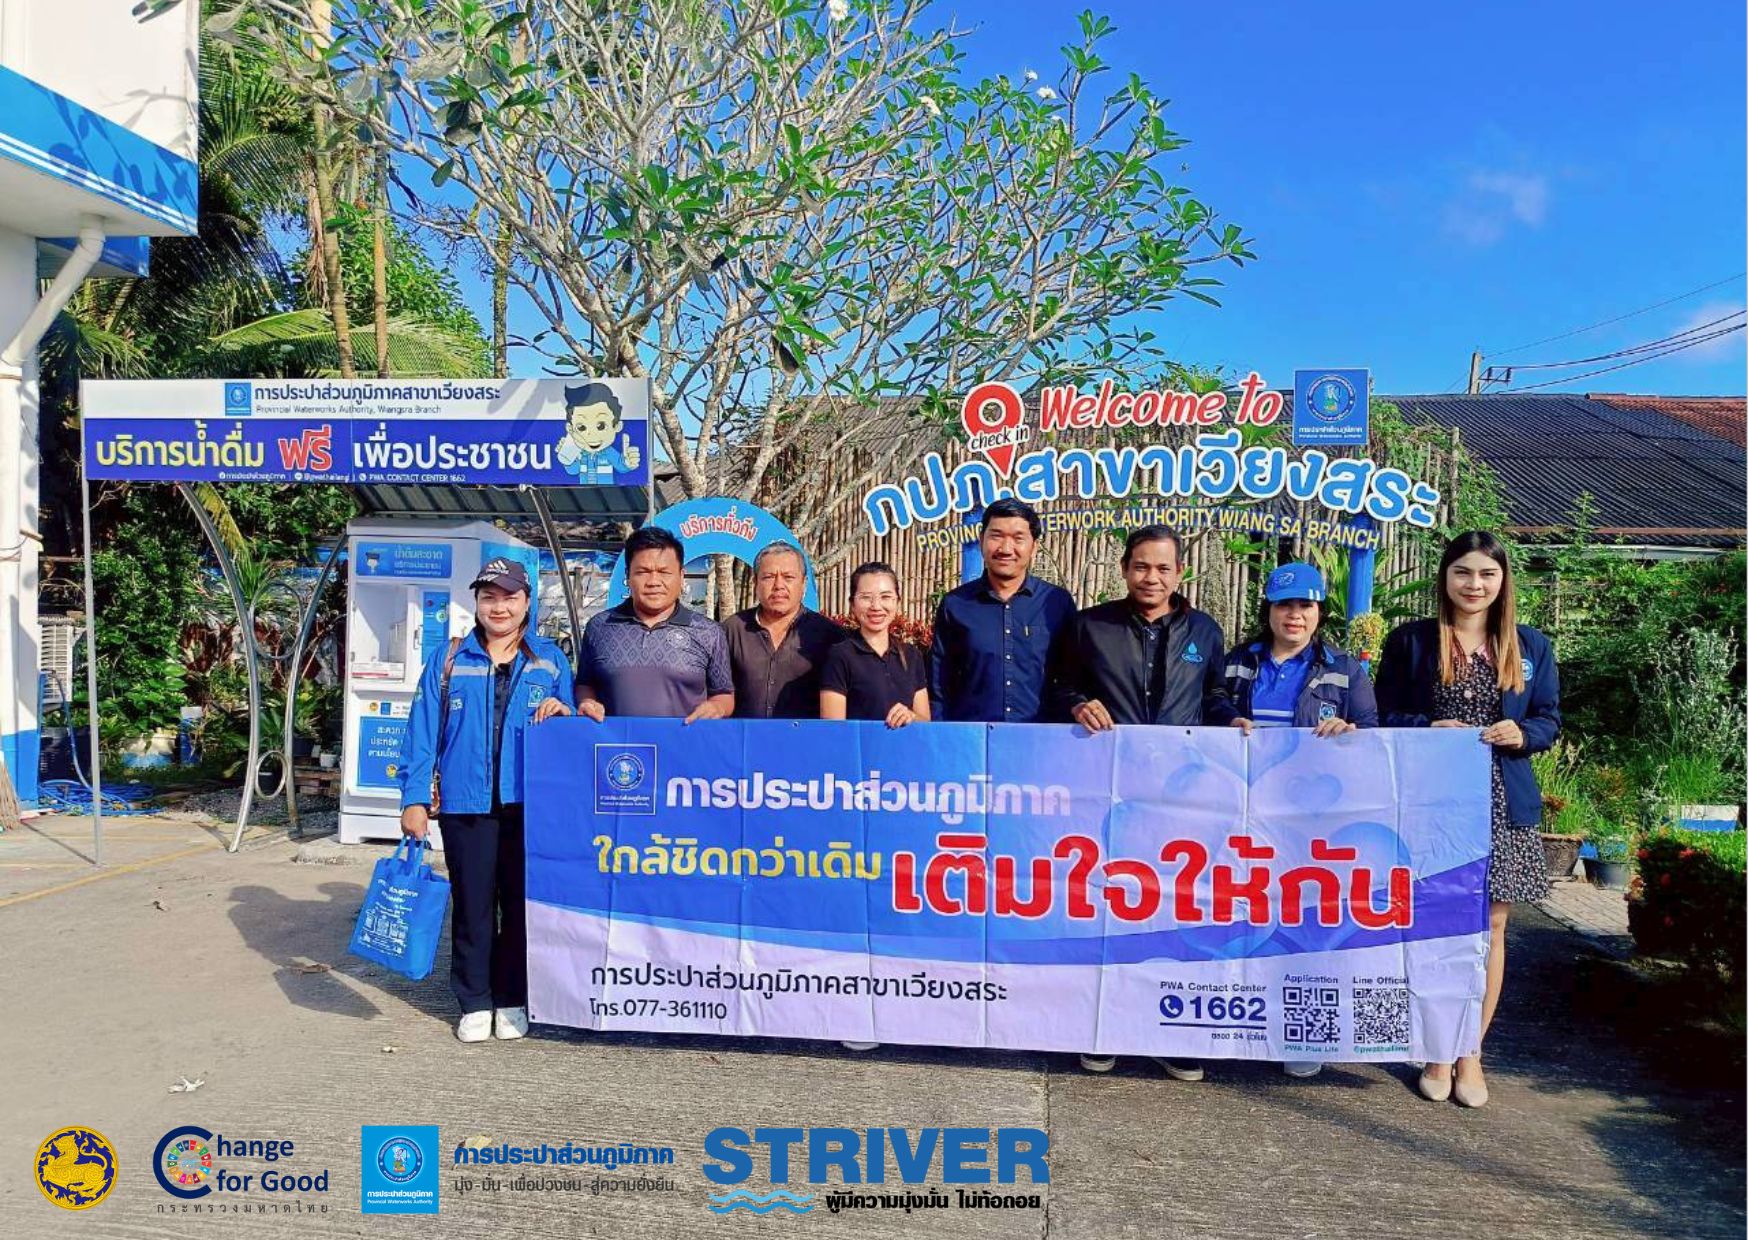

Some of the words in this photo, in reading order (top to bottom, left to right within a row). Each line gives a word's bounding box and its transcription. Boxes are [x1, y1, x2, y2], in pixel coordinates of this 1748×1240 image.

[255, 382, 500, 405] การประปาส่วนภูมิภาคสาขาเวียงสระ
[1040, 378, 1226, 431] Welcome
[1234, 371, 1284, 426] to
[96, 420, 264, 467] บริการน้ำดื่ม
[278, 424, 332, 470] ฟรี
[353, 422, 551, 470] เพื่อประชาชน
[970, 426, 1011, 449] check
[1014, 425, 1030, 442] in
[864, 429, 1440, 535] กปภ.สาขาเวียงสระ
[916, 521, 983, 551] PROVINC
[1038, 509, 1117, 532] TERWORK
[1121, 507, 1214, 527] AUTHORITY
[1218, 509, 1276, 534] WIANG
[1279, 516, 1301, 537] SA
[1307, 521, 1381, 549] BRANCH
[665, 771, 1070, 823] การประปาส่วนภูมิภาค
[593, 833, 882, 881] ใกล้ชิดกว่าเดิม
[893, 834, 1413, 928] เติมใจให้กัน
[591, 963, 1008, 1003] การประปาส่วนภูมิภาคสาขาเวียงสระ
[1160, 981, 1184, 990] PWA
[1188, 983, 1229, 992] Contact
[1232, 984, 1267, 992] Center
[1284, 974, 1339, 984] Application
[1353, 976, 1374, 985] Line
[1377, 976, 1410, 985] Official
[588, 998, 727, 1020] โทร.077-361110
[1189, 996, 1267, 1022] 1662
